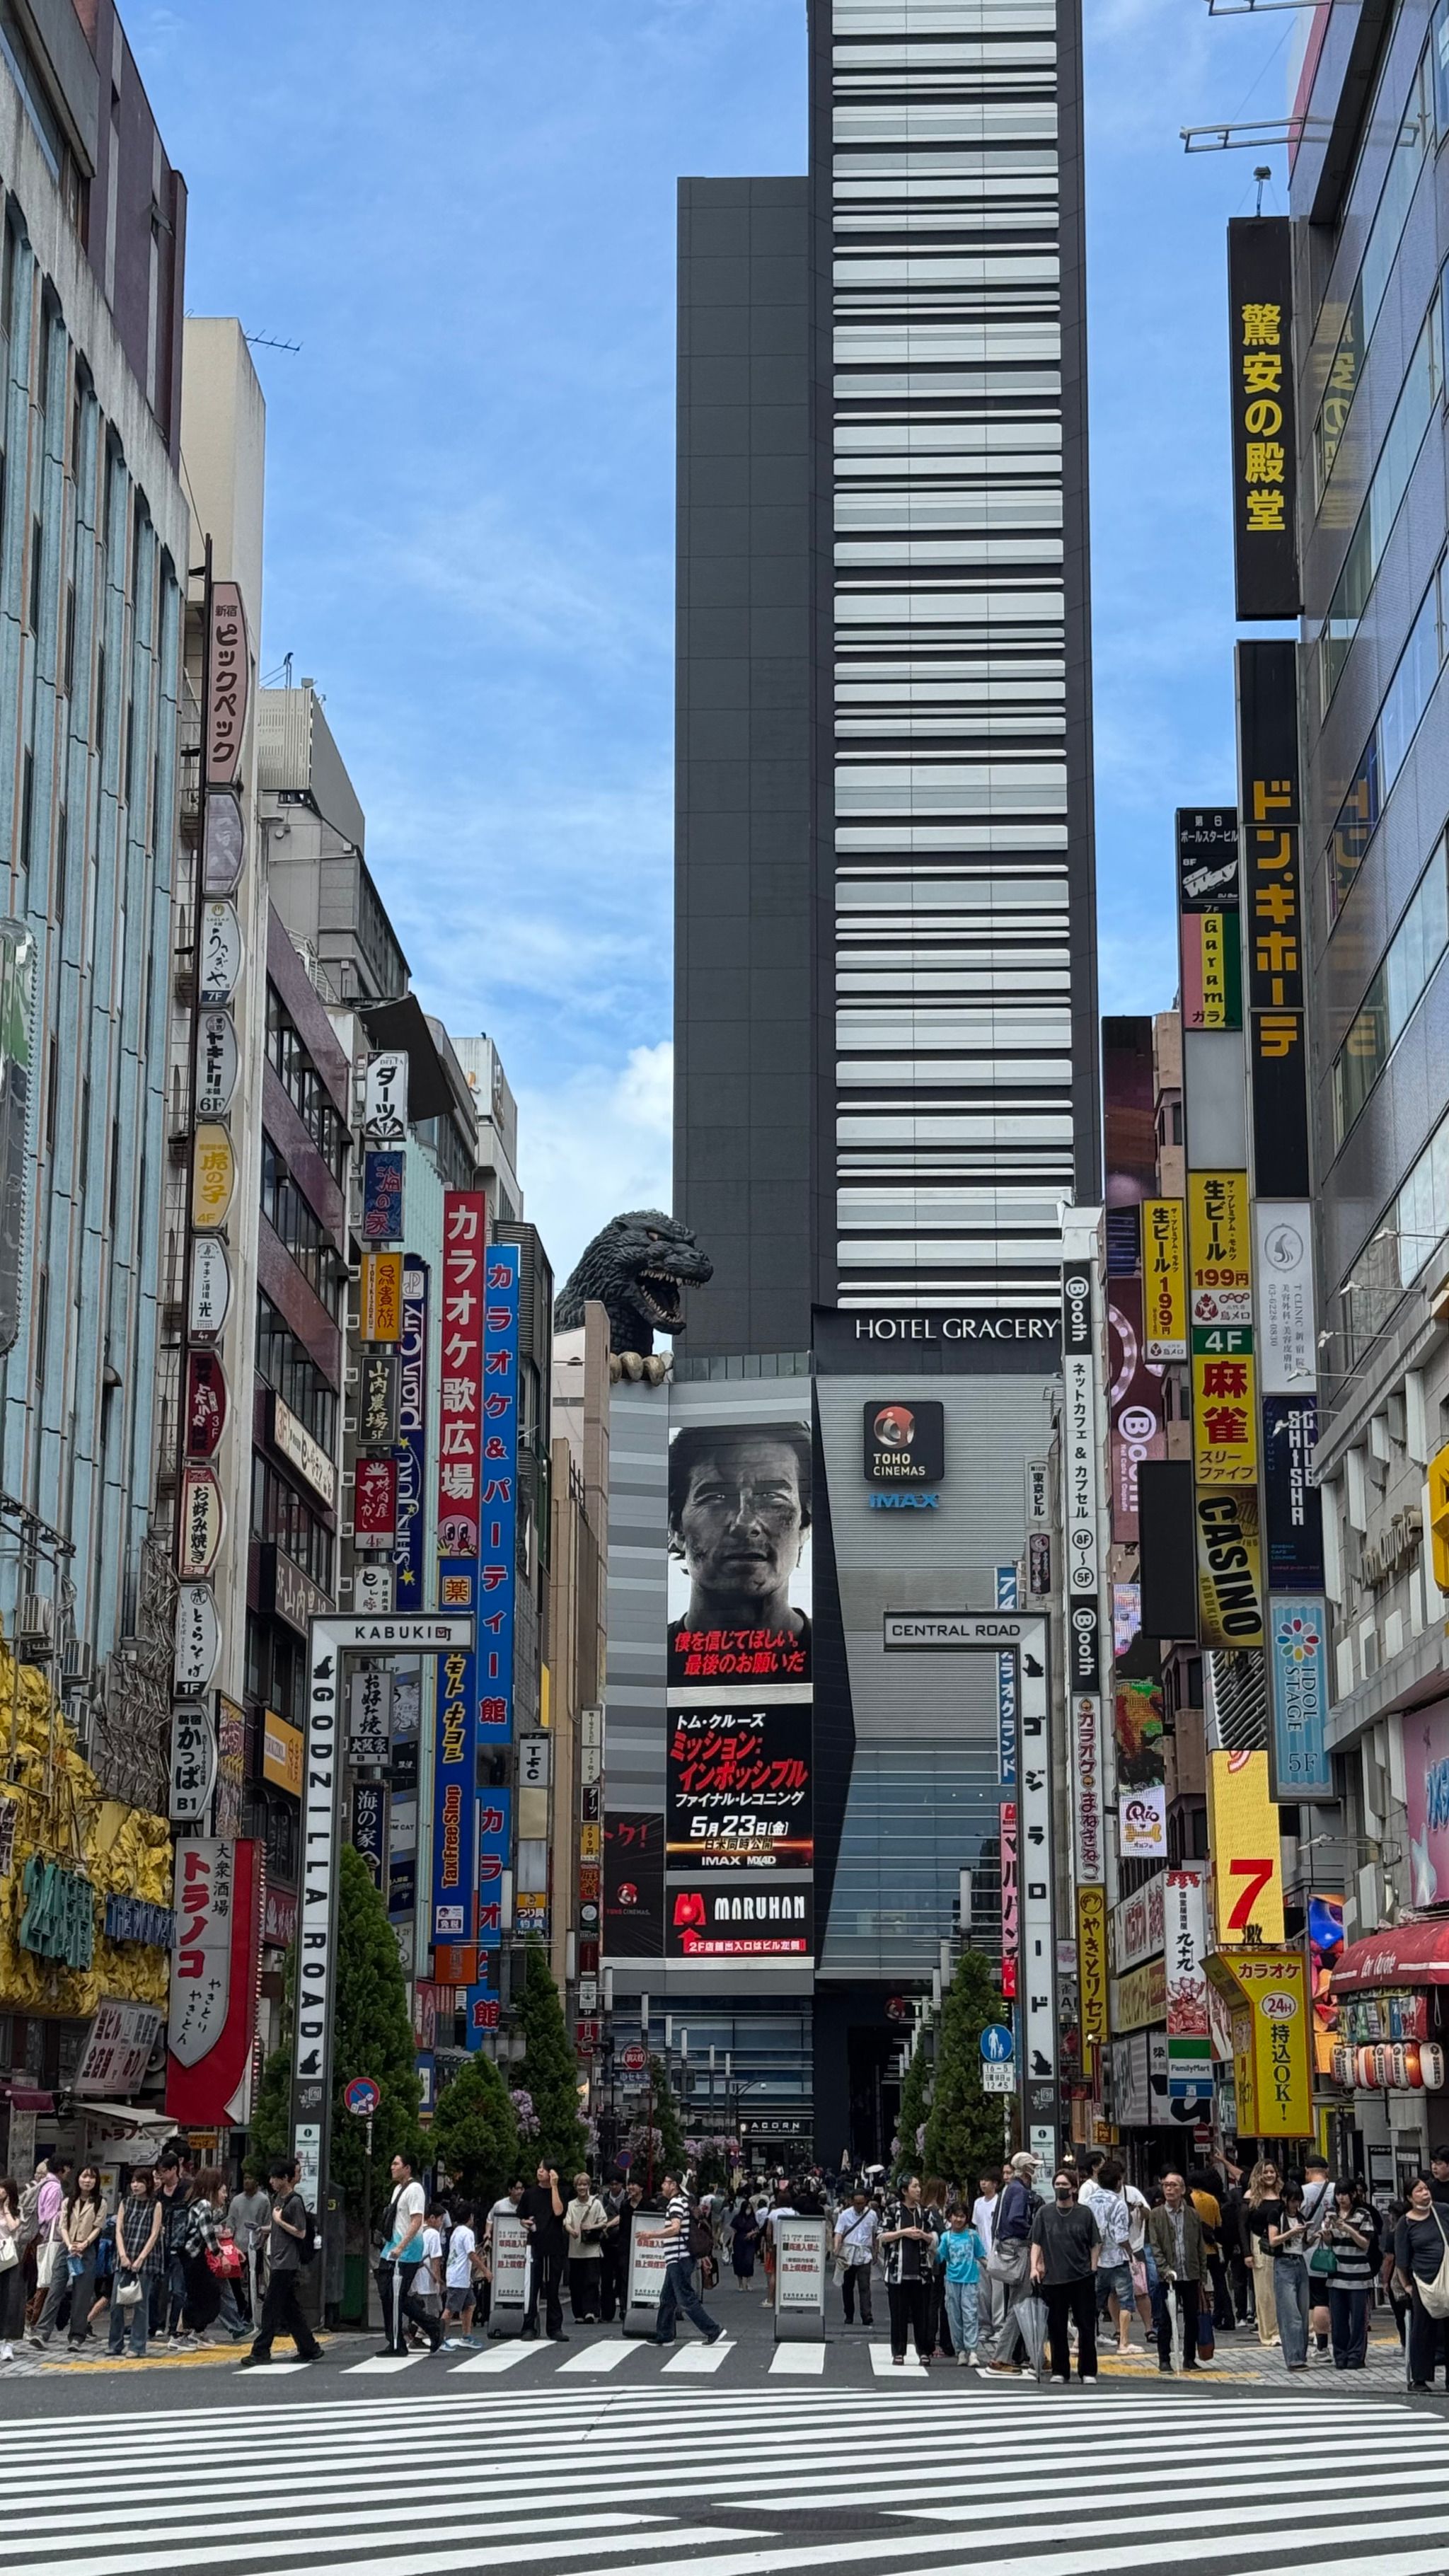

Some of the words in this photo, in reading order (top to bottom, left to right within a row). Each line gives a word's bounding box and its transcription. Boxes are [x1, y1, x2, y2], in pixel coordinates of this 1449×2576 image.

[1242, 304, 1285, 531] 驚安の殿堂
[215, 606, 238, 616] 新宿
[213, 623, 238, 762] ピックペック
[1254, 780, 1297, 1057] ドン・キホーテ
[206, 928, 228, 988] うさぎや
[1204, 920, 1223, 1003] Garam
[207, 992, 223, 1001] 7F
[200, 1098, 224, 1111] 6F
[376, 1066, 398, 1122] ダーツ
[200, 1152, 228, 1204] 虎の子
[197, 1213, 215, 1223] 4F
[366, 1168, 400, 1232] 海の家
[1153, 1208, 1171, 1273] 生ビール
[1203, 1180, 1227, 1261] 生ビール
[1195, 1269, 1249, 1287] 199円
[198, 1301, 213, 1317] 光
[1158, 1277, 1172, 1335] 199円
[855, 1319, 937, 1339] HOTEL
[942, 1318, 1060, 1339] GRACERY
[1205, 1330, 1242, 1352] 4F
[441, 1205, 478, 1499] カラオケ歌広場
[366, 1361, 388, 1430] 山内農場
[1073, 1363, 1087, 1440] ネットカフェ
[1202, 1361, 1249, 1444] 麻雀
[371, 1431, 383, 1439] 5F
[1075, 1447, 1087, 1463] &
[872, 1453, 911, 1465] TOHO
[872, 1466, 926, 1476] CINEMAS
[1199, 1451, 1242, 1465] スリー
[1199, 1467, 1254, 1480] ファイブ
[1288, 1411, 1303, 1526] SHISHA
[393, 1452, 419, 1564] SHINJUKU
[868, 1494, 940, 1508] IMAX
[1033, 1473, 1045, 1517] 東京ビル
[1075, 1466, 1089, 1519] カプセル
[192, 1486, 209, 1565] お好み焼き
[366, 1535, 385, 1547] 4F
[1075, 1533, 1090, 1545] 8F
[1076, 1572, 1091, 1583] 5F
[1198, 1496, 1263, 1637] CASINO
[446, 1581, 468, 1602] 薬
[675, 1629, 799, 1653] 僕を信じてほしい。
[892, 1625, 971, 1636] CENTRAL
[975, 1625, 1021, 1636] ROAD
[1072, 1607, 1097, 1676] Booth
[683, 1651, 806, 1676] 最後のお願いだ
[183, 1684, 201, 1694] 1F
[443, 1653, 468, 1764] モトキヨシ
[1284, 1667, 1303, 1733] STAGE
[1300, 1667, 1317, 1722] IDOL
[178, 1715, 201, 1726] 新宿
[677, 1713, 766, 1730] トム・クルーズ
[175, 1726, 202, 1790] かっぱ
[669, 1731, 763, 1762] ミッション:
[1288, 1753, 1317, 1773] 5F
[679, 1759, 809, 1792] インポッシブル
[176, 1798, 196, 1810] B1
[305, 1687, 335, 1906] GODZILLA
[675, 1791, 805, 1808] ファイナル・レコニング
[212, 1842, 231, 1917] 大衆酒場
[702, 1856, 741, 1866] IMAX
[1023, 1716, 1048, 2013] ゴジラロード
[714, 1895, 805, 1921] MARUHAN
[1227, 1859, 1274, 1930] 7
[178, 1852, 212, 1979] トラノコ
[1175, 1932, 1195, 1972] 九十九
[1238, 1963, 1301, 1980] カラオケ
[299, 1932, 327, 2038] ROAD
[198, 1979, 221, 2033] やきとり
[1170, 2063, 1211, 2073] FamilyMart
[1271, 2024, 1293, 2120] 持込OK!
